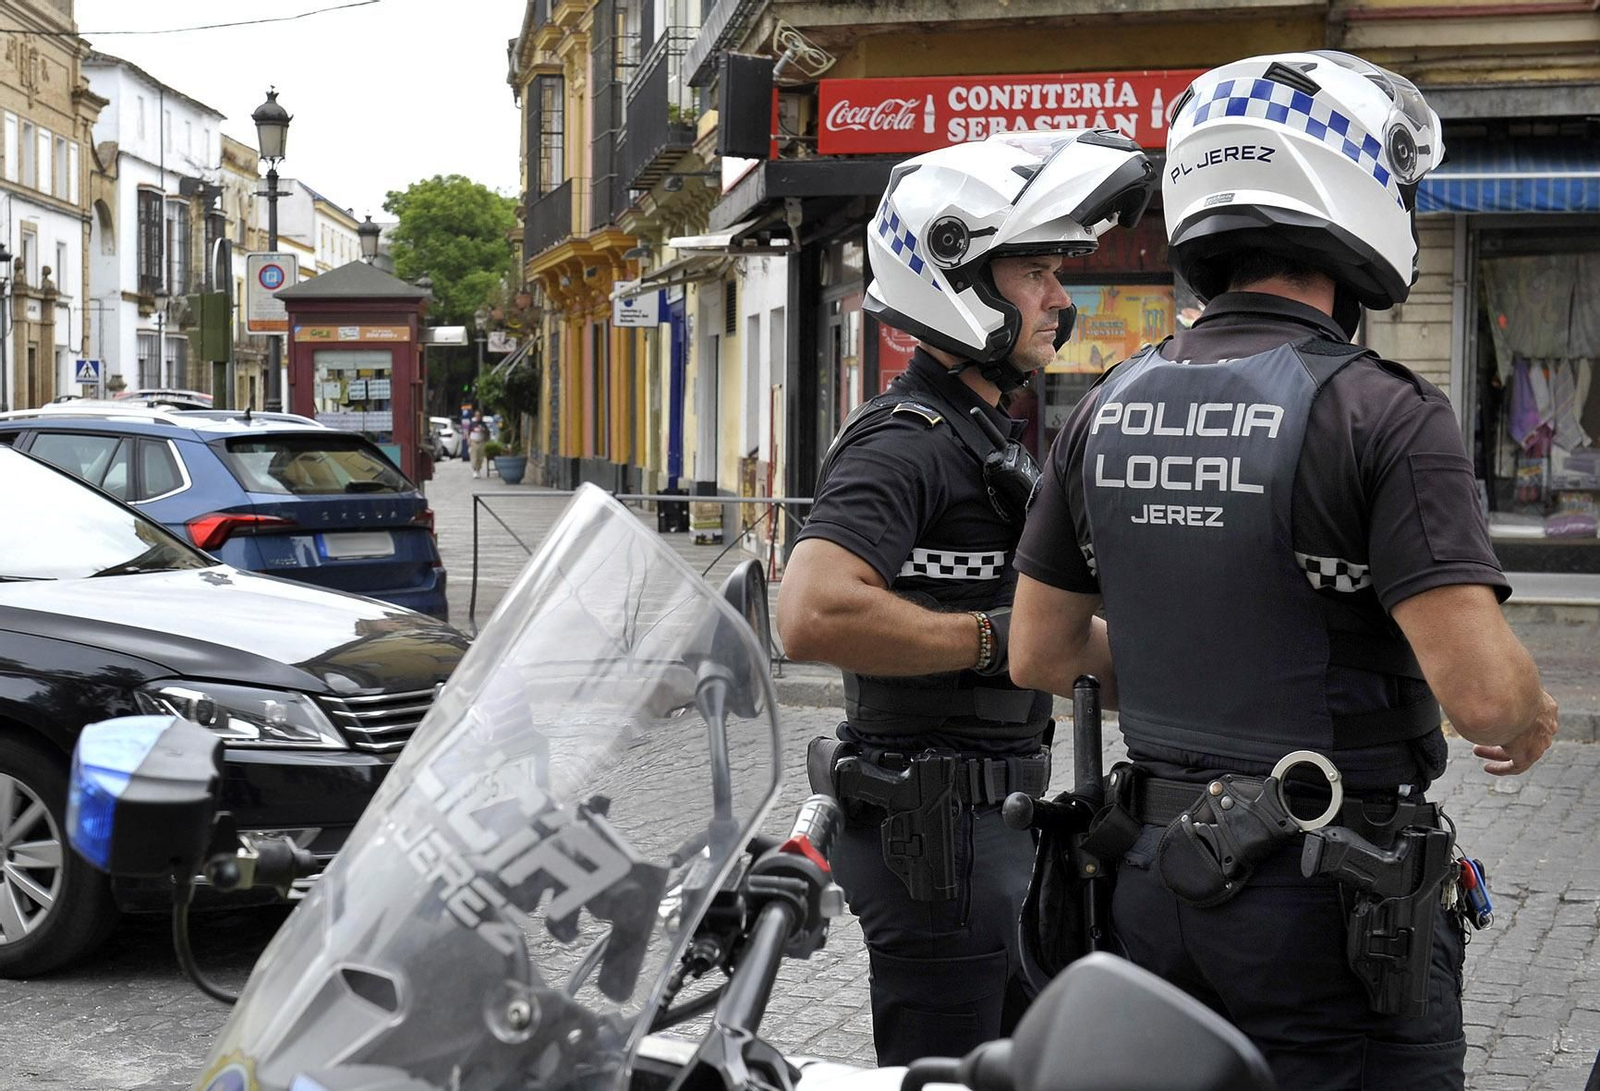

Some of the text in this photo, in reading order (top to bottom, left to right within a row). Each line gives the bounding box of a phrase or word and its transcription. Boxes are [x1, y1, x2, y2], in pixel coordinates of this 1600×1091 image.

[947, 77, 1139, 112] CONFITERÍA
[825, 98, 921, 132] Coca-Cola
[1170, 145, 1276, 185] PL JEREZ
[1091, 402, 1285, 439] POLICIA
[1095, 454, 1265, 494] LOCAL
[1130, 504, 1224, 527] JEREZ
